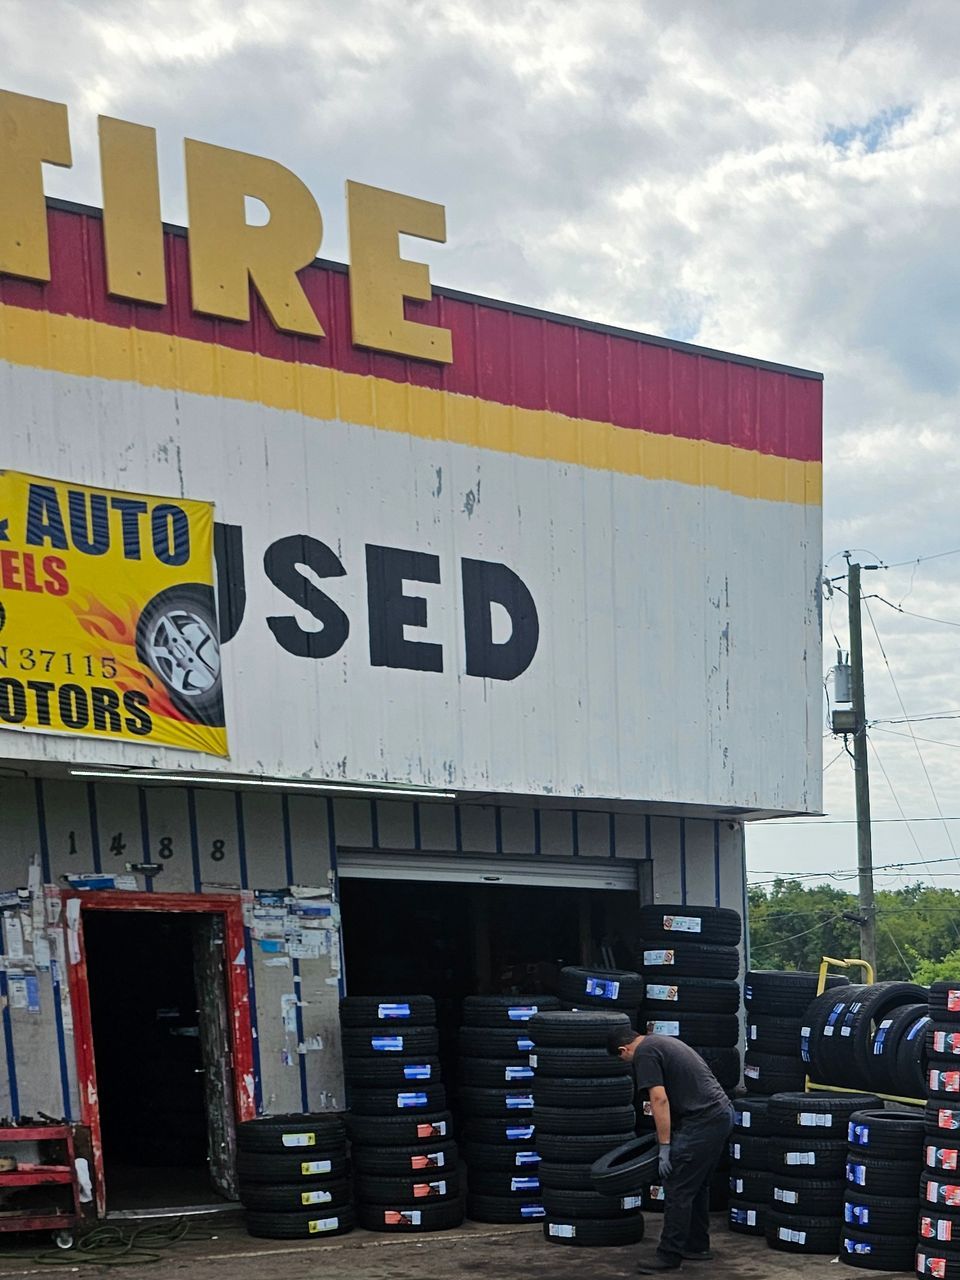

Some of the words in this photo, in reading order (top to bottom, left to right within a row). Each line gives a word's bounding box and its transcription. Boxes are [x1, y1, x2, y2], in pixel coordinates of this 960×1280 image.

[0, 89, 453, 364] TIRE
[26, 483, 190, 567] AUTO
[19, 648, 118, 679] 37115
